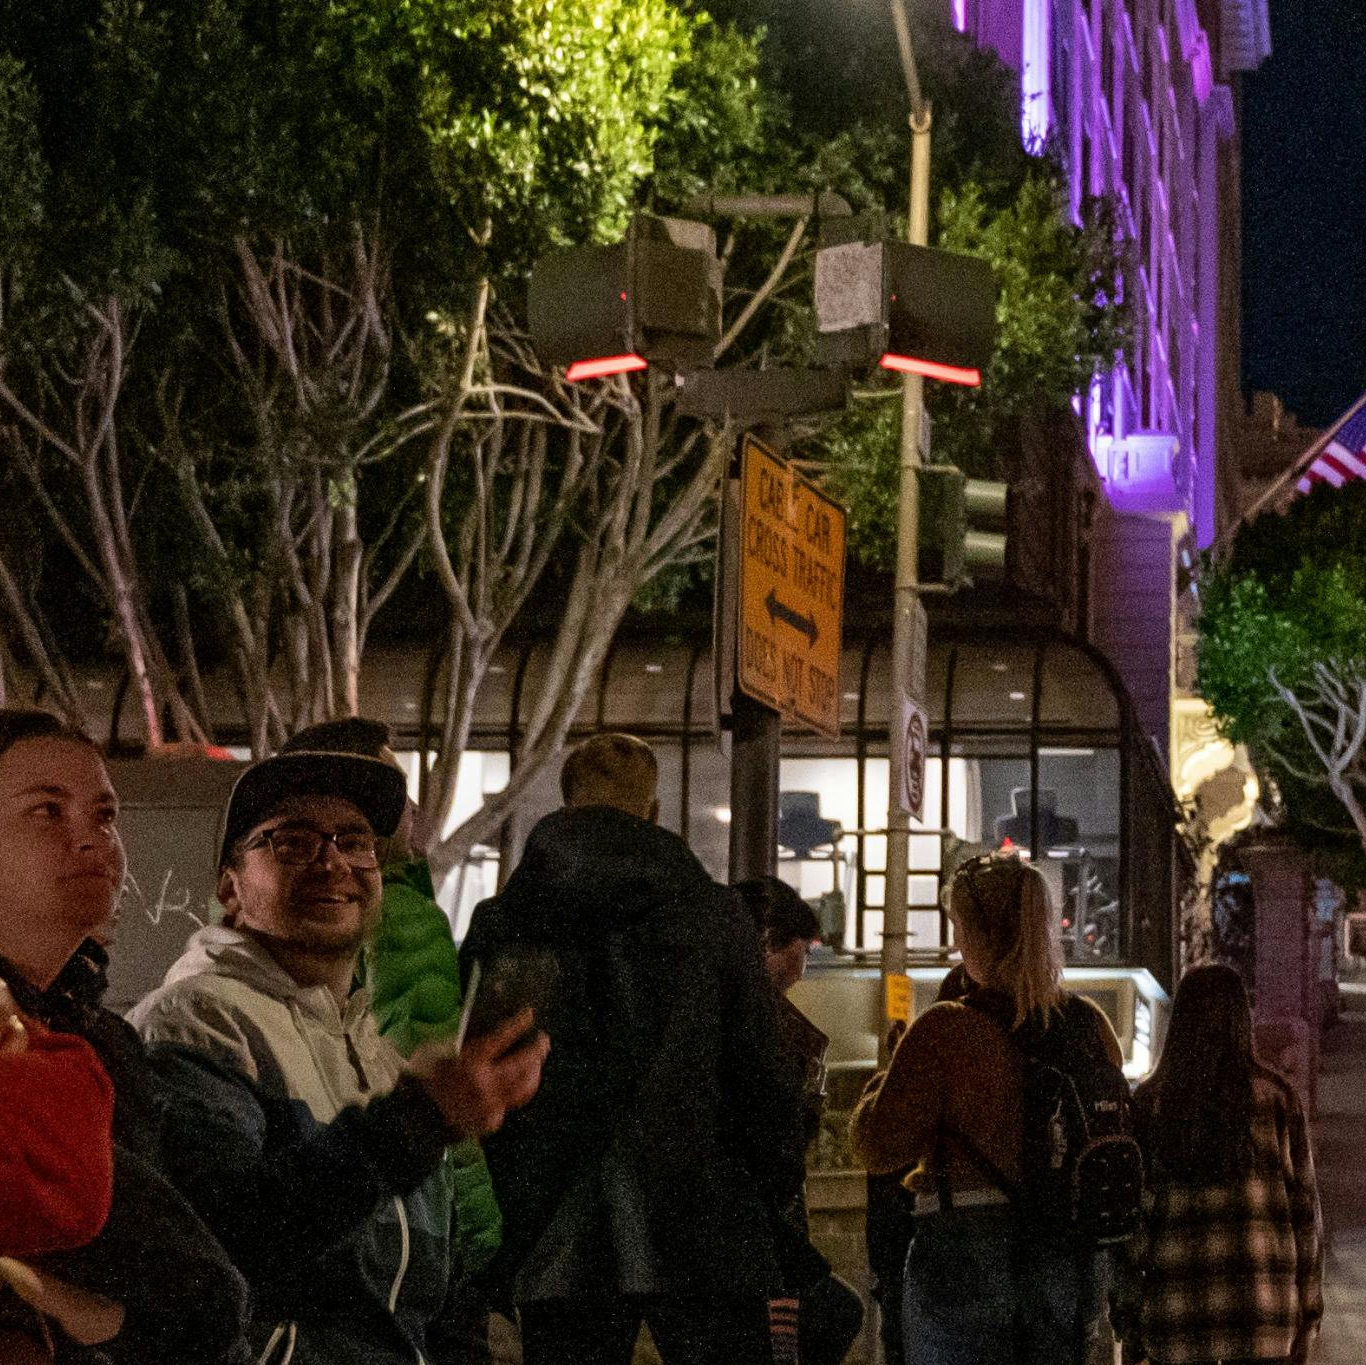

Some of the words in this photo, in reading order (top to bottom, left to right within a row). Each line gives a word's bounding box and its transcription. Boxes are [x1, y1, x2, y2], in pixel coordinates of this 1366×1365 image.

[747, 512, 788, 579] CROSS
[792, 544, 837, 612] TRAFFIC
[805, 501, 830, 556] CAR
[745, 626, 777, 684] DOES
[782, 647, 803, 699] NOT
[808, 664, 834, 717] STOP
